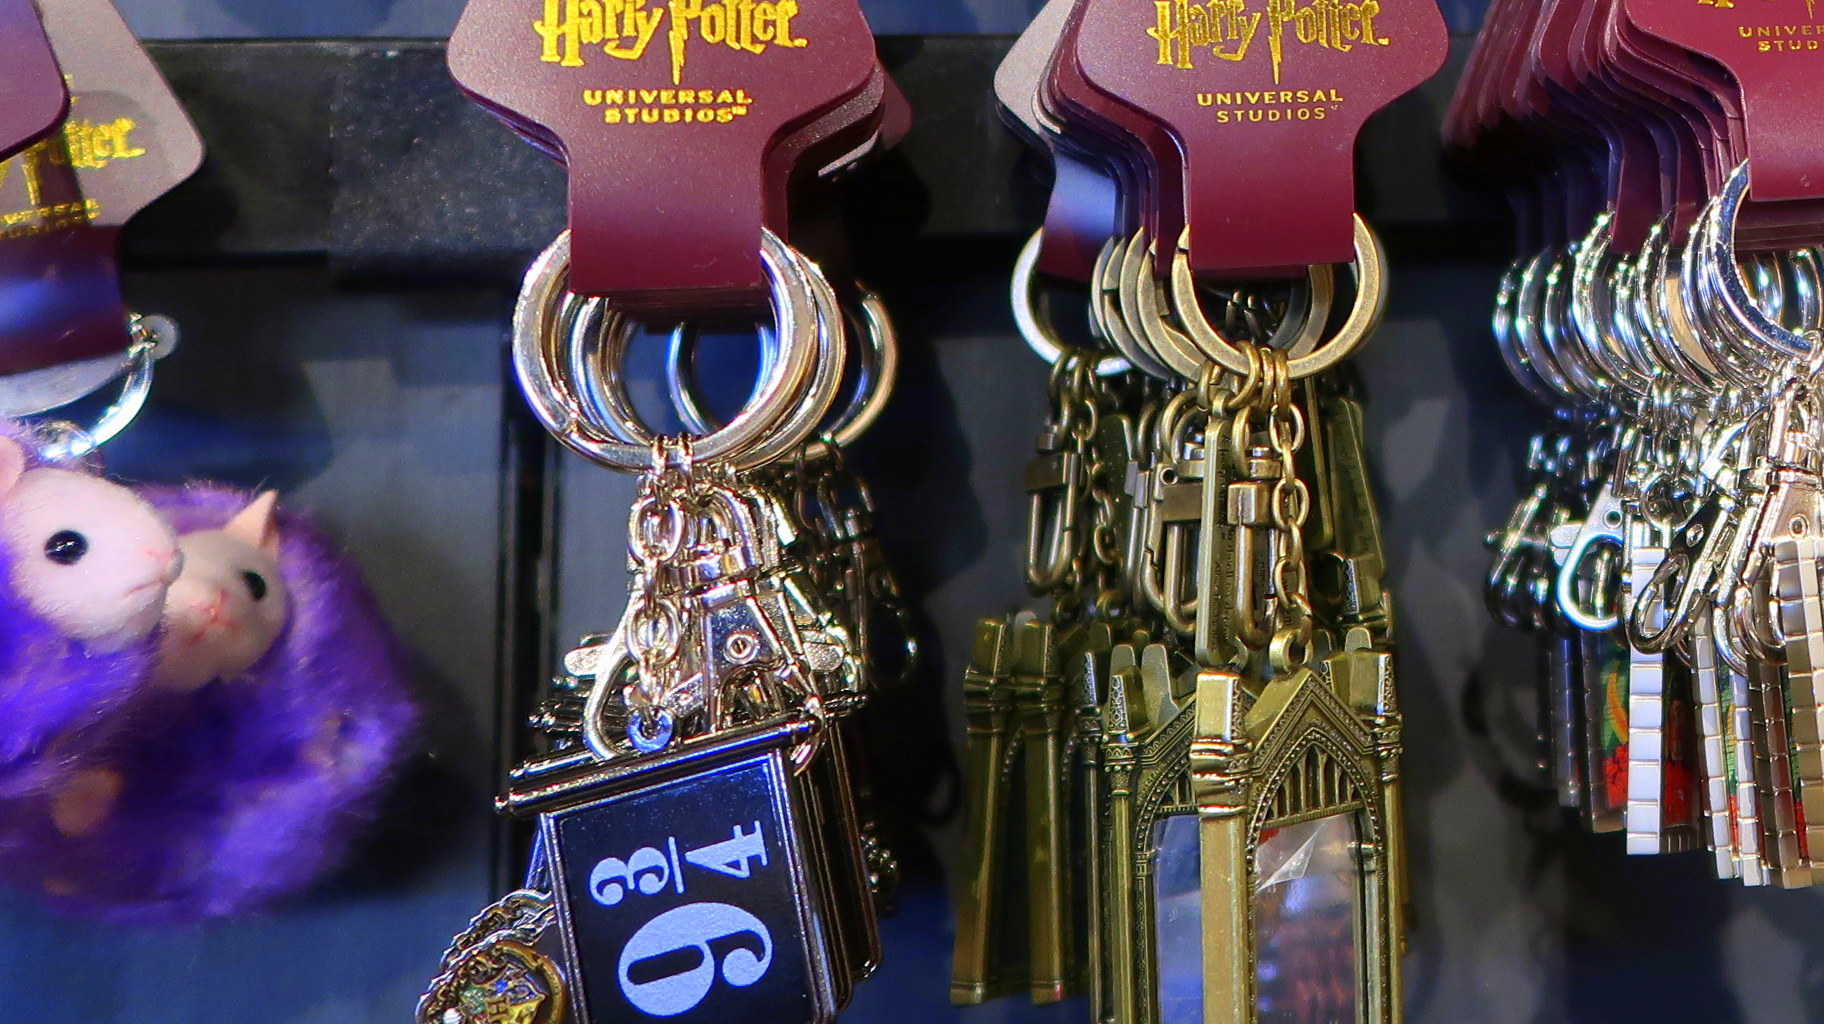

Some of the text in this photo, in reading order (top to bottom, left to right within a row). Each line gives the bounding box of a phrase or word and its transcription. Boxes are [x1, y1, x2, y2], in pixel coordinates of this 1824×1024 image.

[582, 88, 753, 106] UNIVERSAL
[1196, 88, 1344, 107] UNIVERSAL
[617, 901, 774, 1017] 9
